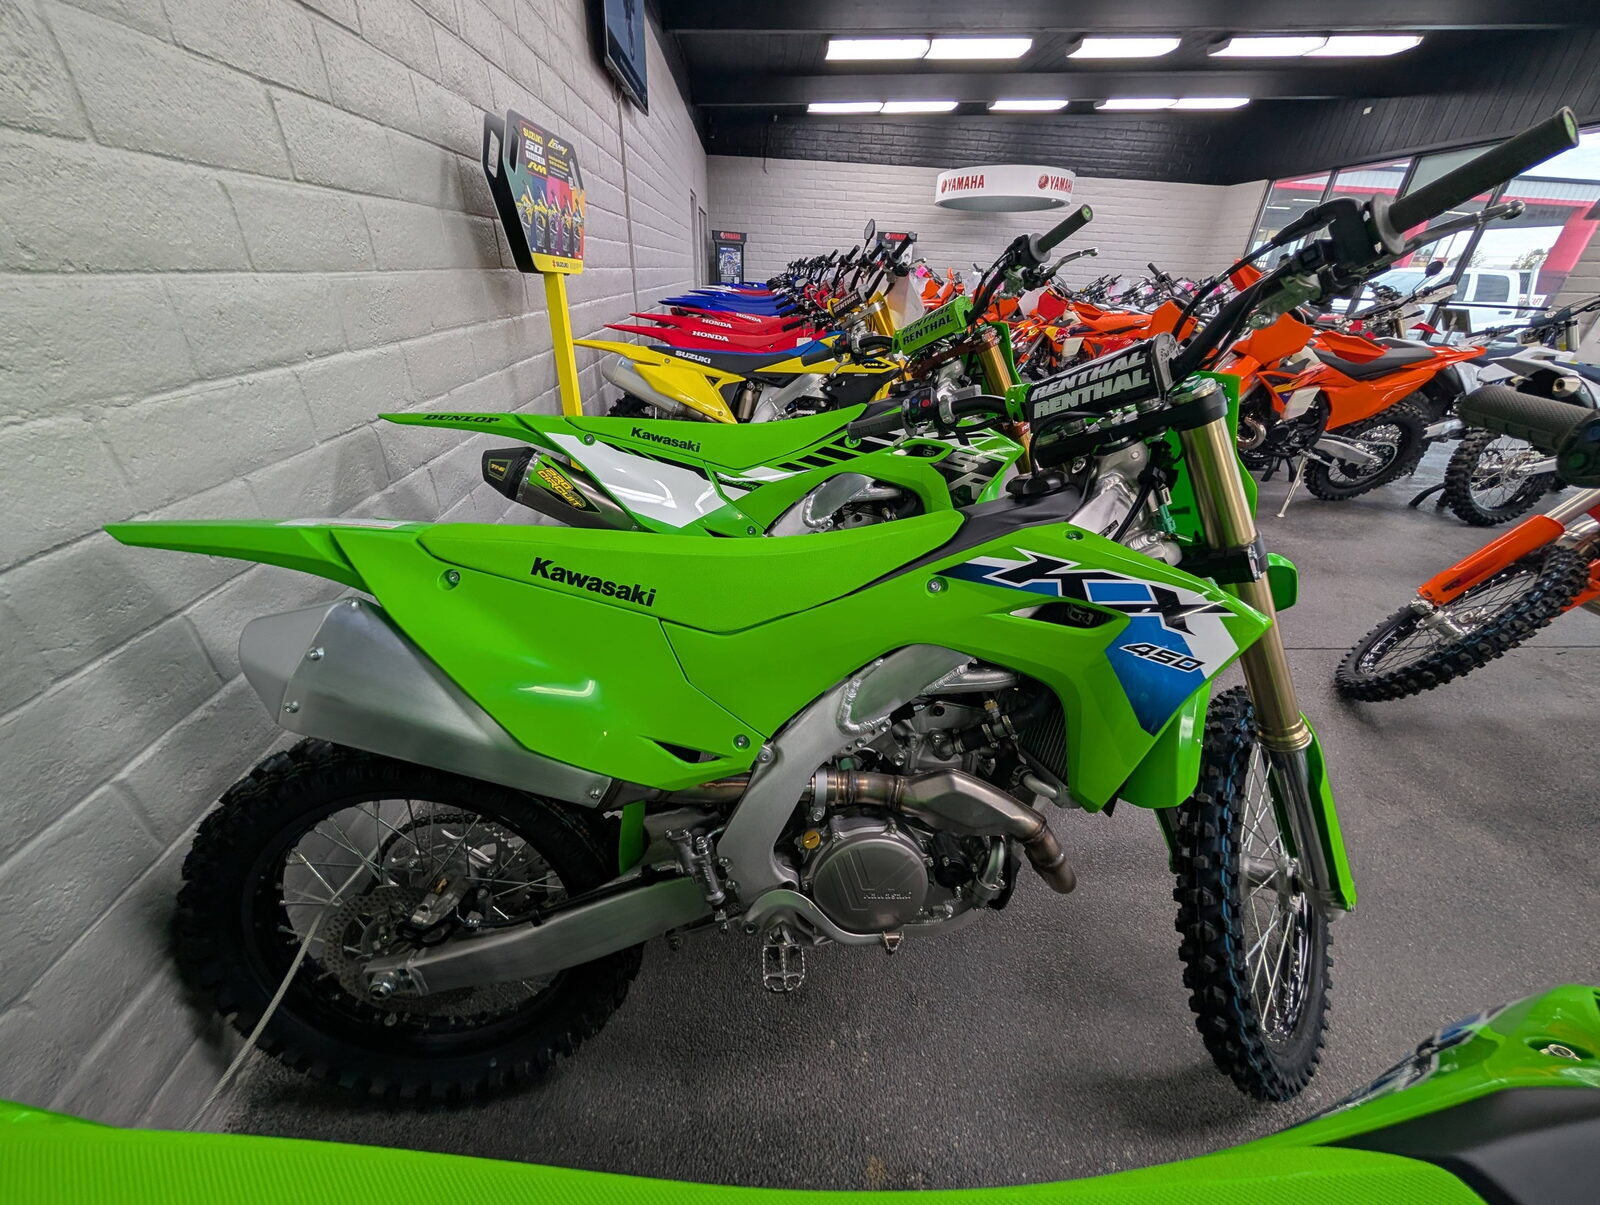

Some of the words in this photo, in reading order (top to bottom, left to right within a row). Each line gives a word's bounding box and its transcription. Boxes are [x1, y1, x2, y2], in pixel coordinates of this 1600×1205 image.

[522, 127, 544, 145] SUZUKI
[947, 175, 985, 192] YAMAHA
[701, 318, 733, 329] HONDA
[735, 312, 762, 323] HONDA
[691, 330, 729, 342] HONDA
[903, 315, 953, 345] RENTHAL
[675, 350, 711, 364] SUZUKI
[1030, 351, 1146, 401] RENTHAL
[1033, 369, 1150, 419] RENTHAL
[422, 414, 500, 424] DUNLOP
[631, 427, 701, 453] Kawasaki
[536, 469, 584, 508] CIRCUIT
[545, 467, 574, 491] PRO
[530, 556, 657, 607] Kawasaki
[1121, 642, 1205, 672] 450
